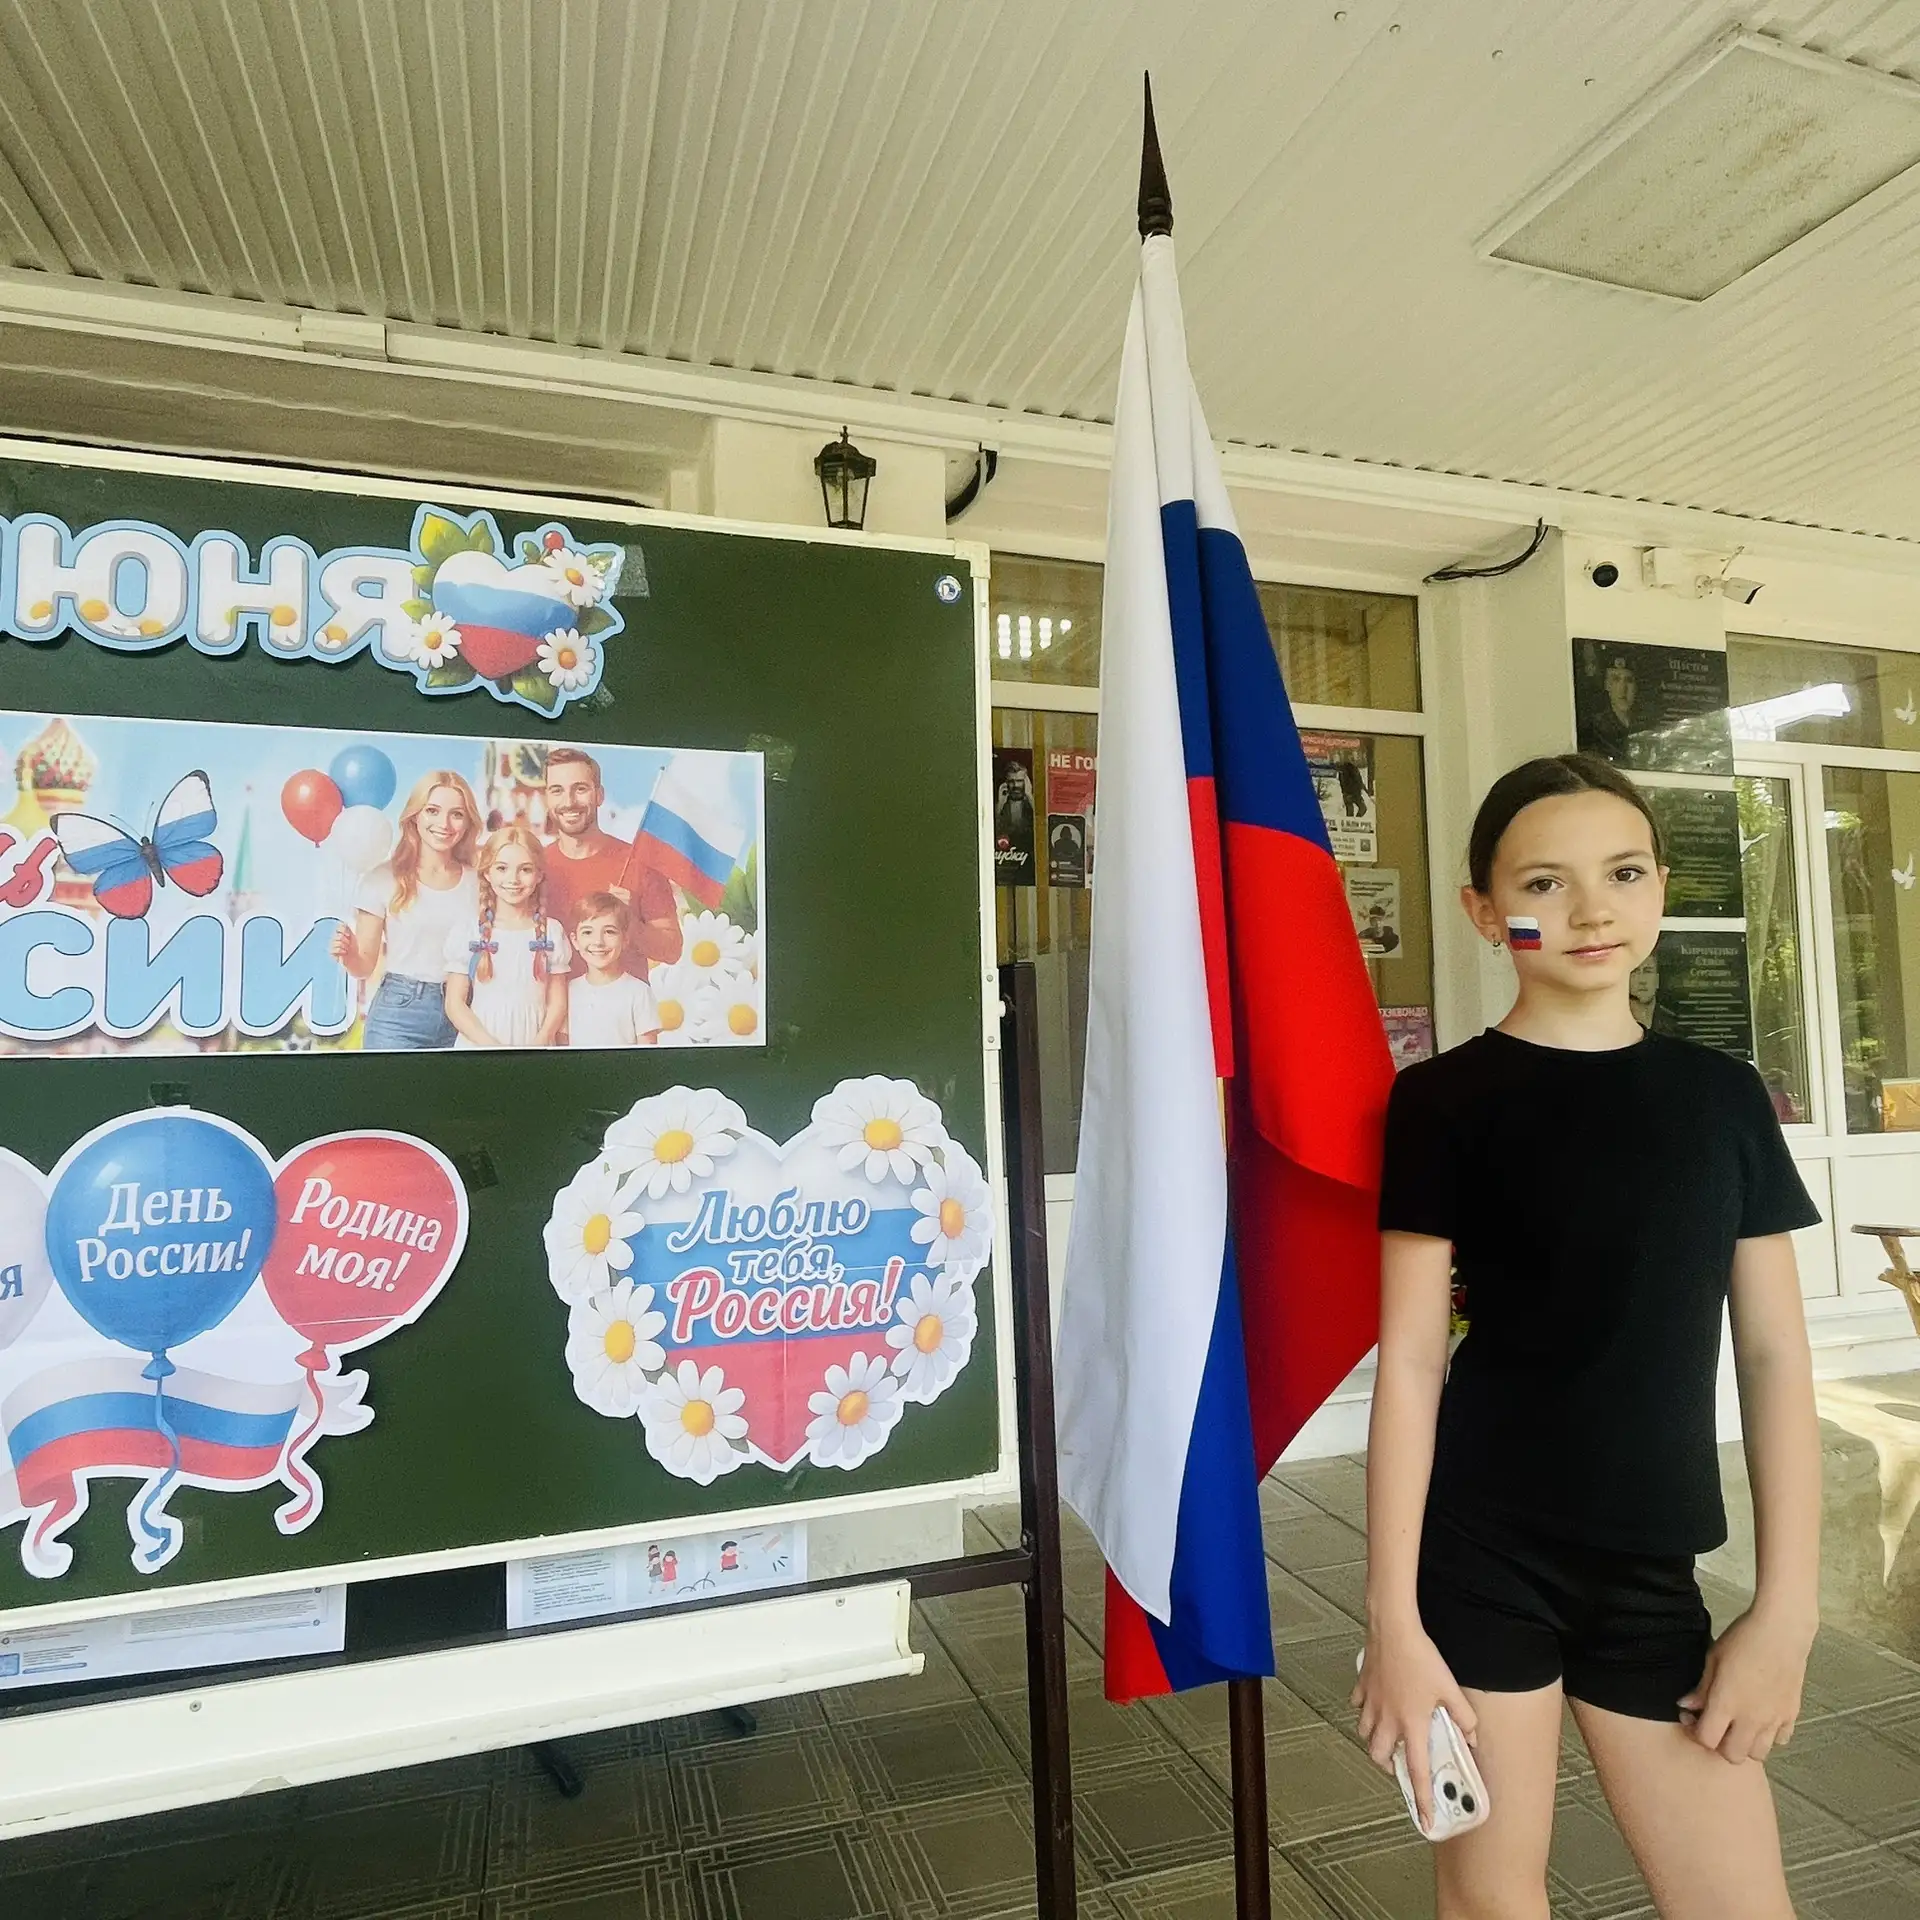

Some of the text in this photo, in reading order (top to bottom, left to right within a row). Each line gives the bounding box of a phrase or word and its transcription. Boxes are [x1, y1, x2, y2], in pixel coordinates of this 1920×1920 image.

[1050, 753, 1098, 771] НЕ ГО
[98, 1181, 233, 1238] День
[289, 1176, 444, 1254] Родина
[669, 1186, 867, 1250] Люблю
[75, 1228, 252, 1284] России!
[294, 1242, 411, 1293] моя!
[729, 1237, 844, 1284] тебя,
[669, 1257, 904, 1342] Россия!
